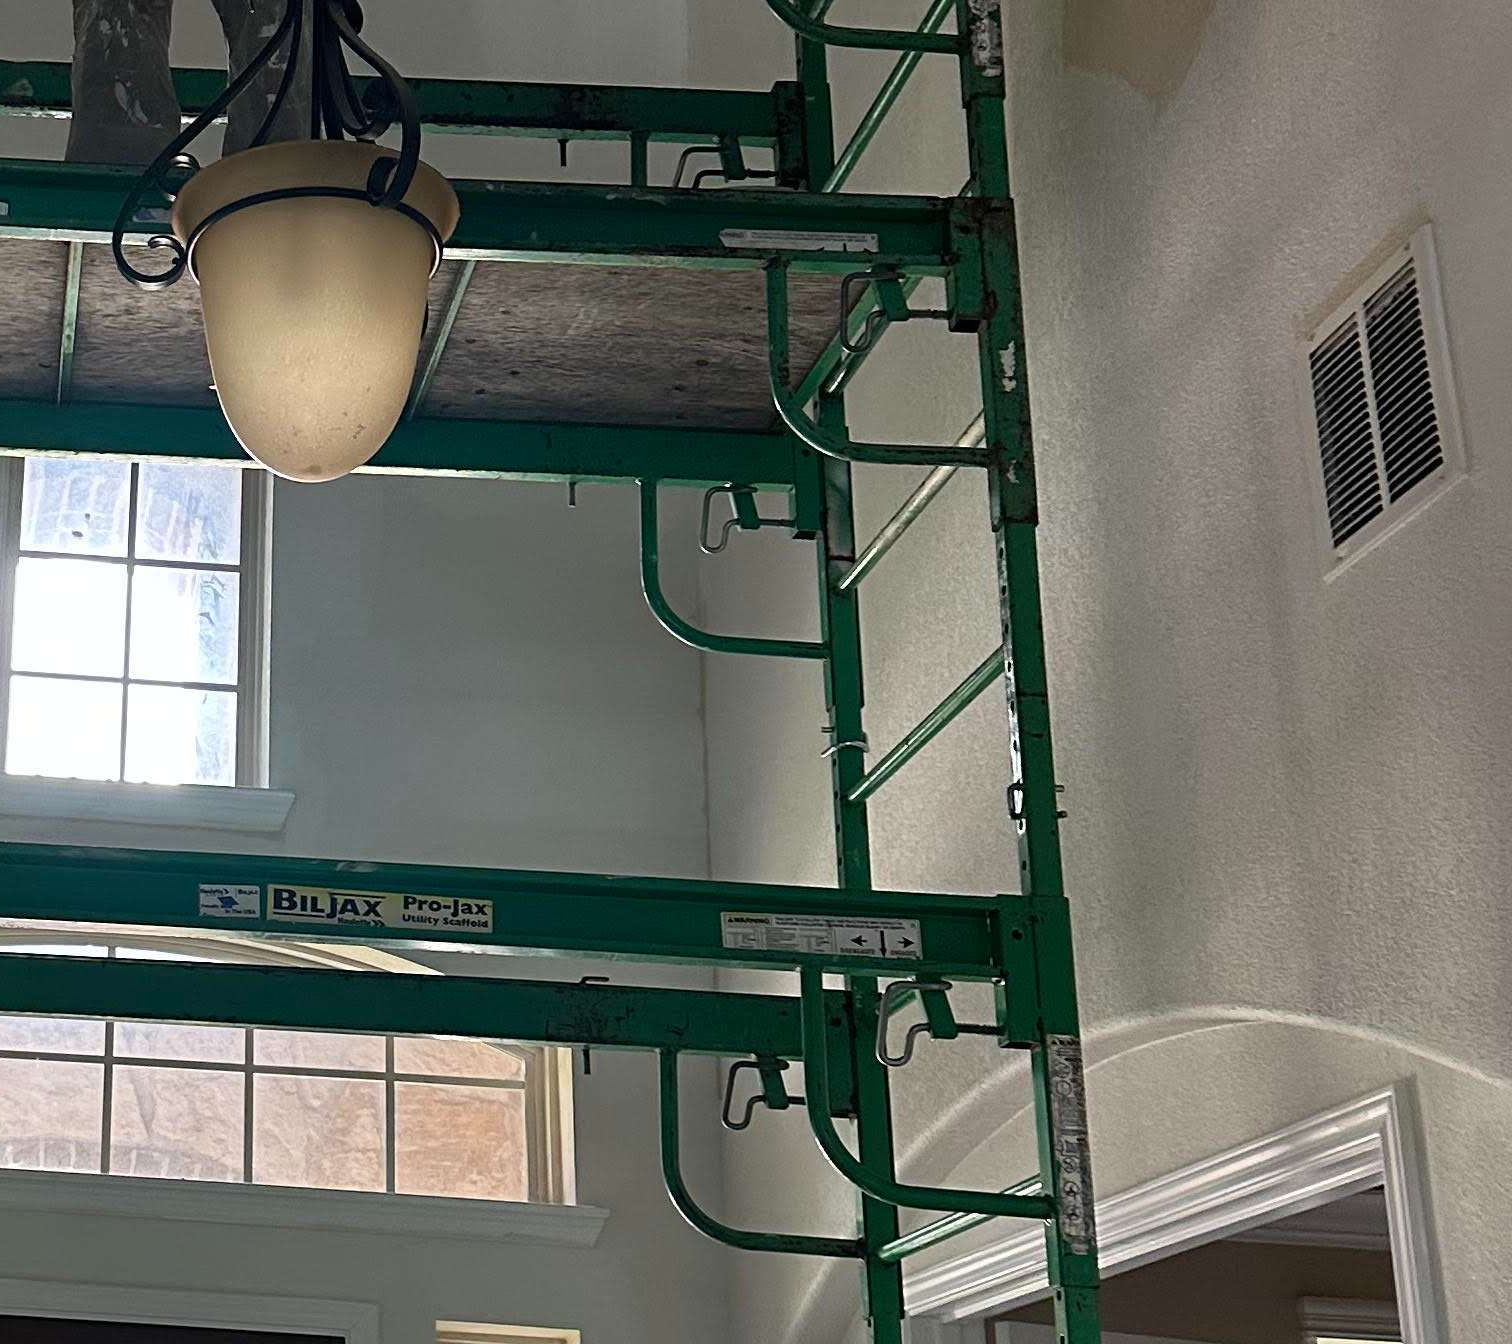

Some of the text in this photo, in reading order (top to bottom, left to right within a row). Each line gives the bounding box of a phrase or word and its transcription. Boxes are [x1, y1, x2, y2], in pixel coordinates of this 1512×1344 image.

[403, 895, 489, 918] Pro-Jax
[402, 914, 488, 929] Utility Scaffold
